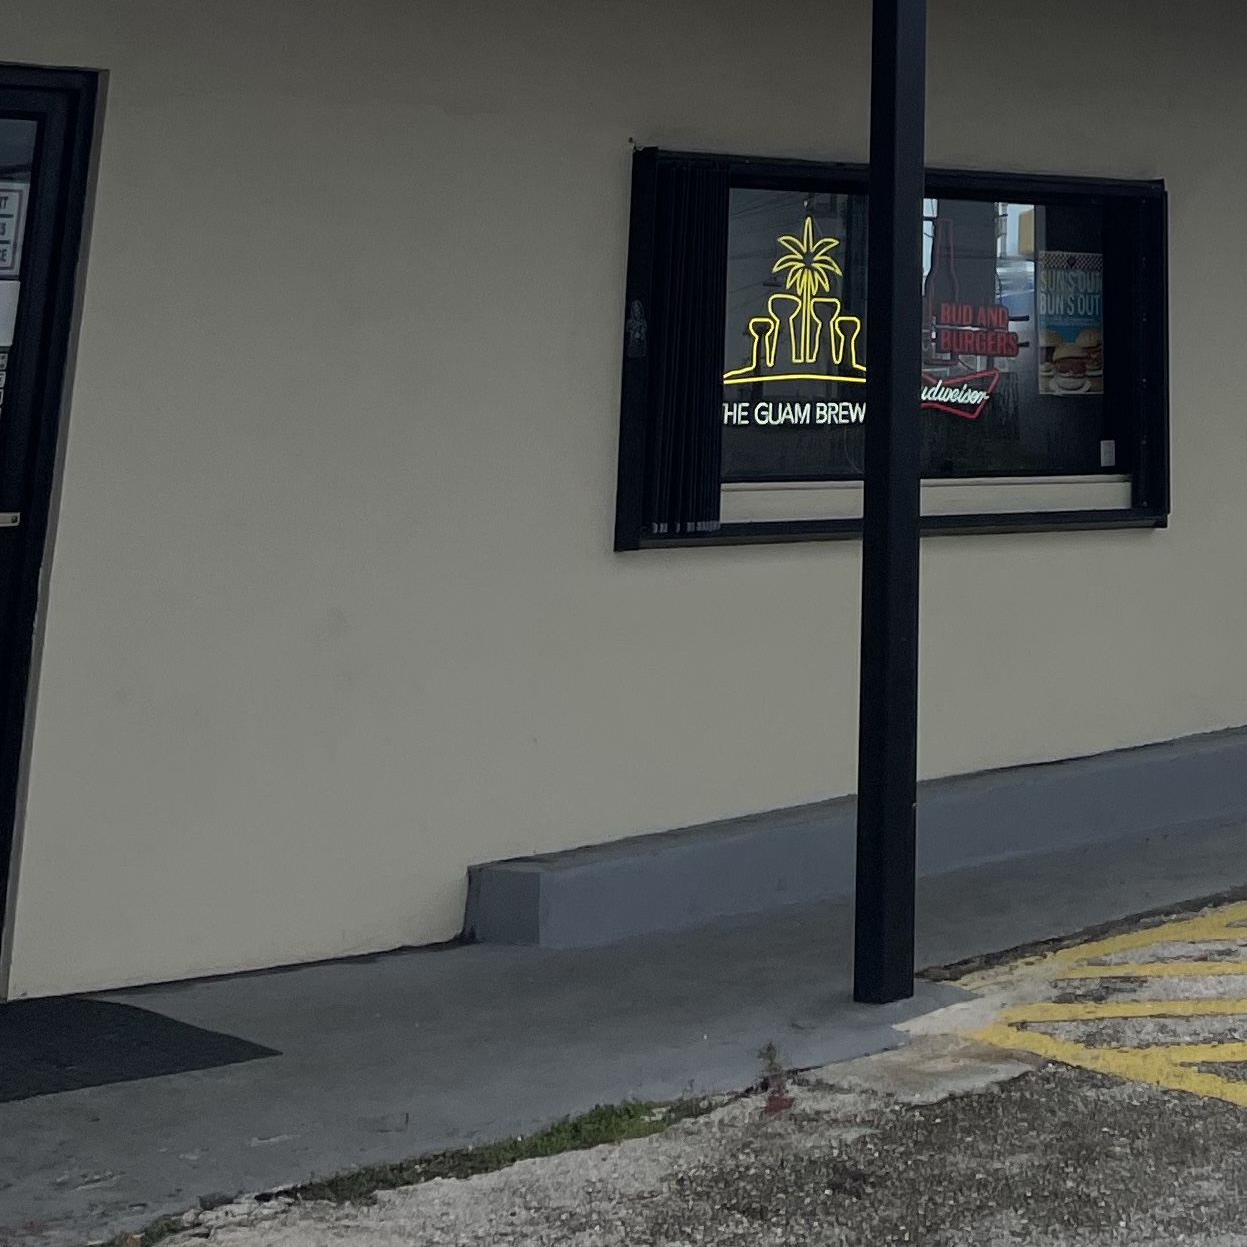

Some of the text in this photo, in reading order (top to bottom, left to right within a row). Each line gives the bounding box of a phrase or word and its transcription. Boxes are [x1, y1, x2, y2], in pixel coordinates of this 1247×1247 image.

[941, 302, 1009, 329] BUD AND
[1077, 294, 1100, 315] OUT
[940, 329, 1018, 355] BURGERS
[921, 380, 990, 404] udweiser
[722, 402, 750, 425] HE
[754, 402, 811, 425] GUAM
